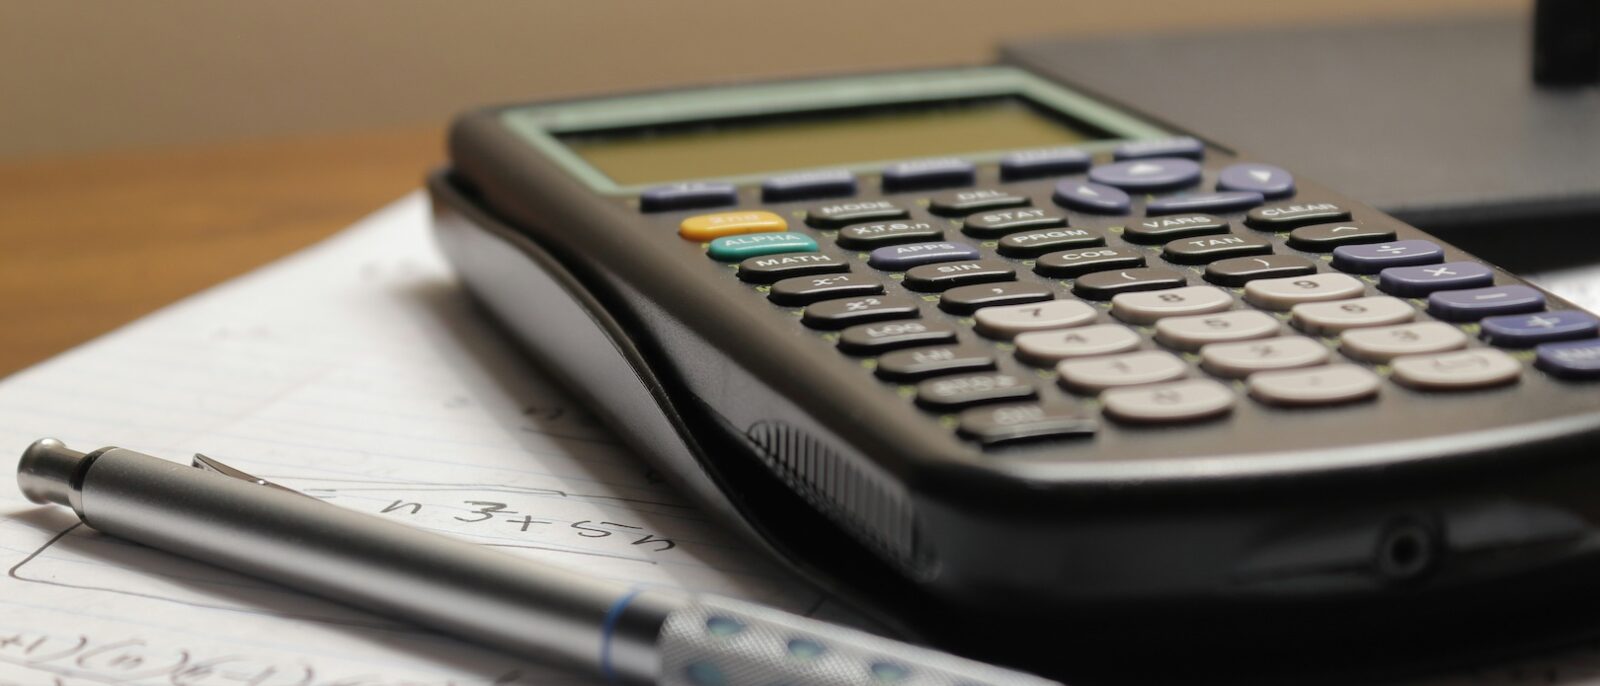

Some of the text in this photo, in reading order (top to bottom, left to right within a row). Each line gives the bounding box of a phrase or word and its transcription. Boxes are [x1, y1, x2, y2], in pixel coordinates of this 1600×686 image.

[957, 189, 1009, 201] DEL
[820, 201, 894, 215] MODE
[1261, 203, 1339, 216] CLEAR
[982, 209, 1046, 223] STAT
[1143, 215, 1212, 229] VARS
[724, 232, 801, 247] ALPHA
[1012, 228, 1090, 245] PRGM
[1188, 236, 1245, 249] TAN
[896, 242, 955, 254] APPS
[755, 254, 832, 268] MATH
[1062, 249, 1119, 261] COS
[936, 263, 982, 274] SIN
[1292, 278, 1321, 291] 9
[865, 322, 928, 338] LOG
